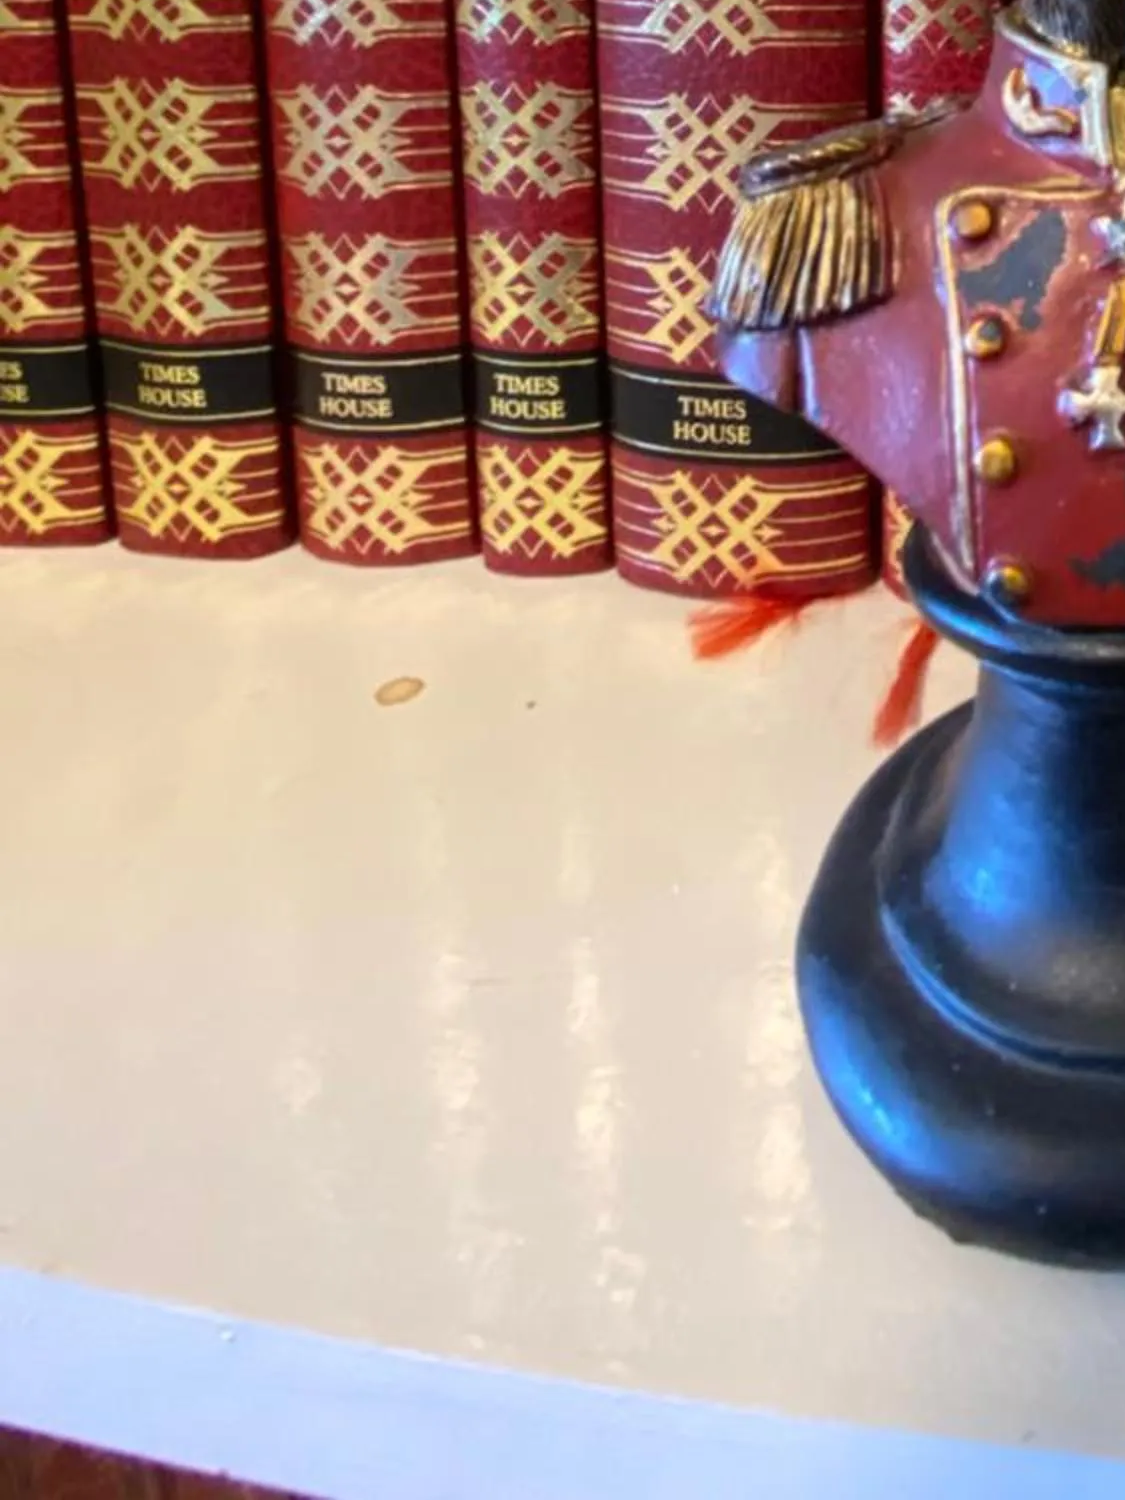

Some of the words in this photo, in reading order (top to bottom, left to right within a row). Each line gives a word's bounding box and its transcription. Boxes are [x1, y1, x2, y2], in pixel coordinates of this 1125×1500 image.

[140, 361, 200, 384] TIMES
[321, 372, 386, 395] TIMES
[493, 373, 560, 395] TIMES
[138, 385, 207, 409] HOUSE
[318, 397, 393, 419] HOUSE
[489, 397, 566, 420] HOUSE
[678, 395, 747, 421] TIMES
[672, 420, 751, 446] HOUSE
